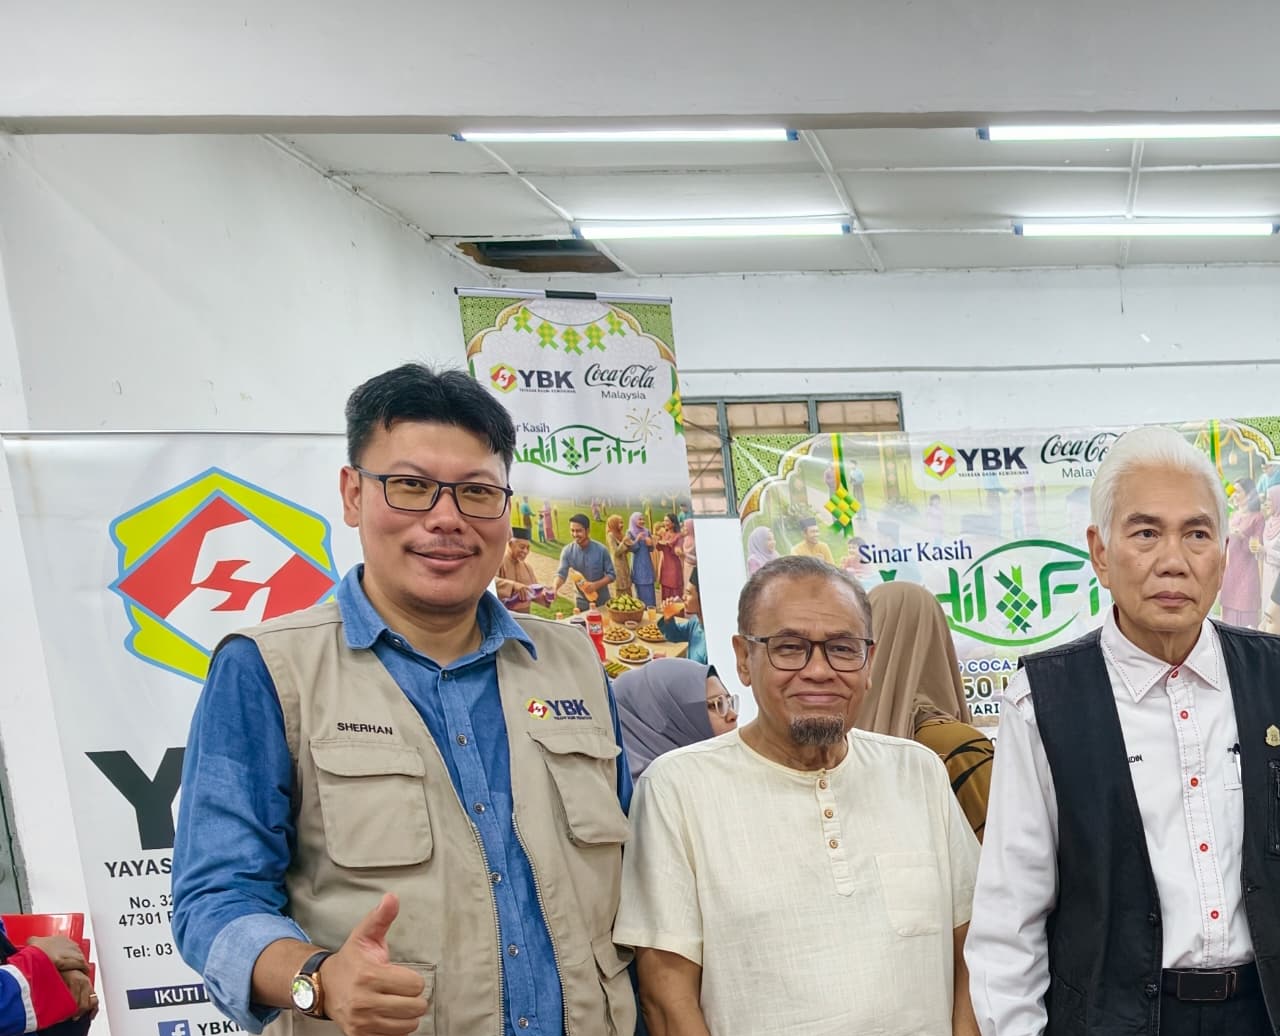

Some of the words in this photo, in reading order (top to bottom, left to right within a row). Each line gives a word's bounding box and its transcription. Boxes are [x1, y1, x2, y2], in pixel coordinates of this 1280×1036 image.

[518, 369, 575, 389] YBK
[584, 363, 657, 389] Coca-Cola
[601, 390, 647, 400] Malaysia
[522, 422, 550, 433] Kasih
[582, 435, 647, 464] Fitri
[957, 446, 1028, 471] YBK
[858, 544, 912, 564] Sinar
[916, 541, 973, 563] Kasih
[967, 660, 1017, 672] COCA-
[963, 677, 992, 698] 50
[545, 699, 590, 716] YBK
[337, 722, 393, 735] SHERHAN
[104, 857, 172, 878] YAYAS
[130, 896, 155, 909] No.
[118, 913, 162, 927] 47301
[124, 945, 151, 959] Tel:
[155, 943, 173, 956] 03
[154, 988, 200, 1005] IKUTI
[198, 1020, 244, 1036] YBK
